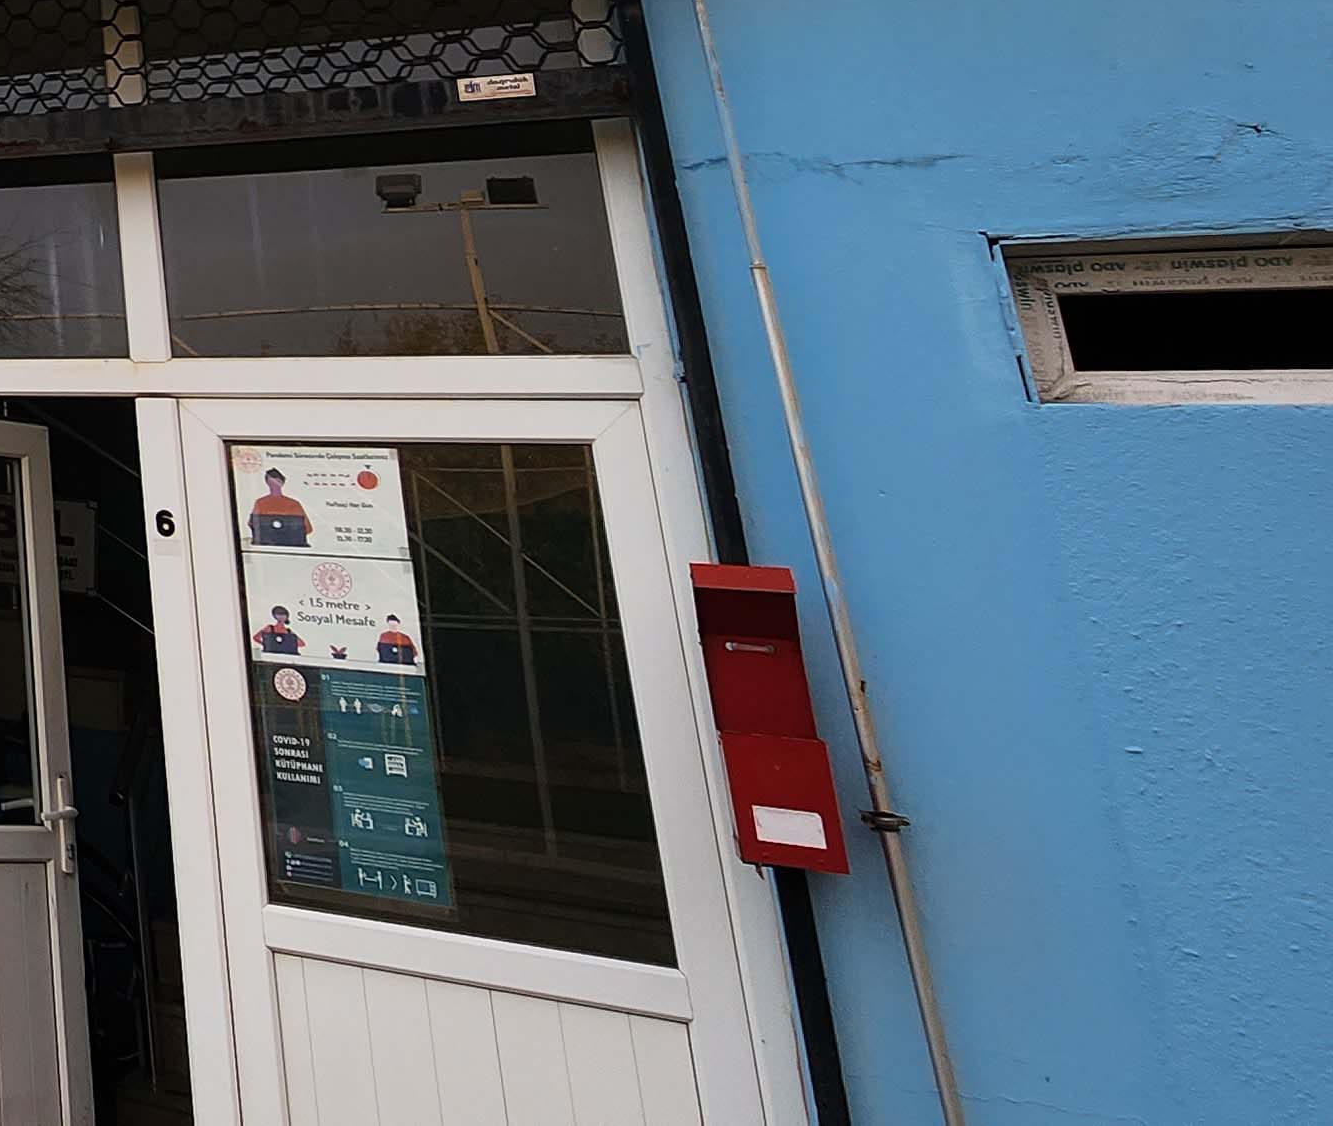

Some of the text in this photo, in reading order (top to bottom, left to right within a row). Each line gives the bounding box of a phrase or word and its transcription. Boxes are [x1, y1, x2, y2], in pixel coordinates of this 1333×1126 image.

[155, 509, 176, 537] 6
[326, 600, 360, 611] metre
[297, 611, 376, 627] Sosyal Mesafe
[272, 735, 310, 747] COVID-19
[274, 747, 309, 759] SONRASI
[275, 758, 324, 773] KÜTÜPHANE
[276, 771, 322, 785] KULLANIMI
